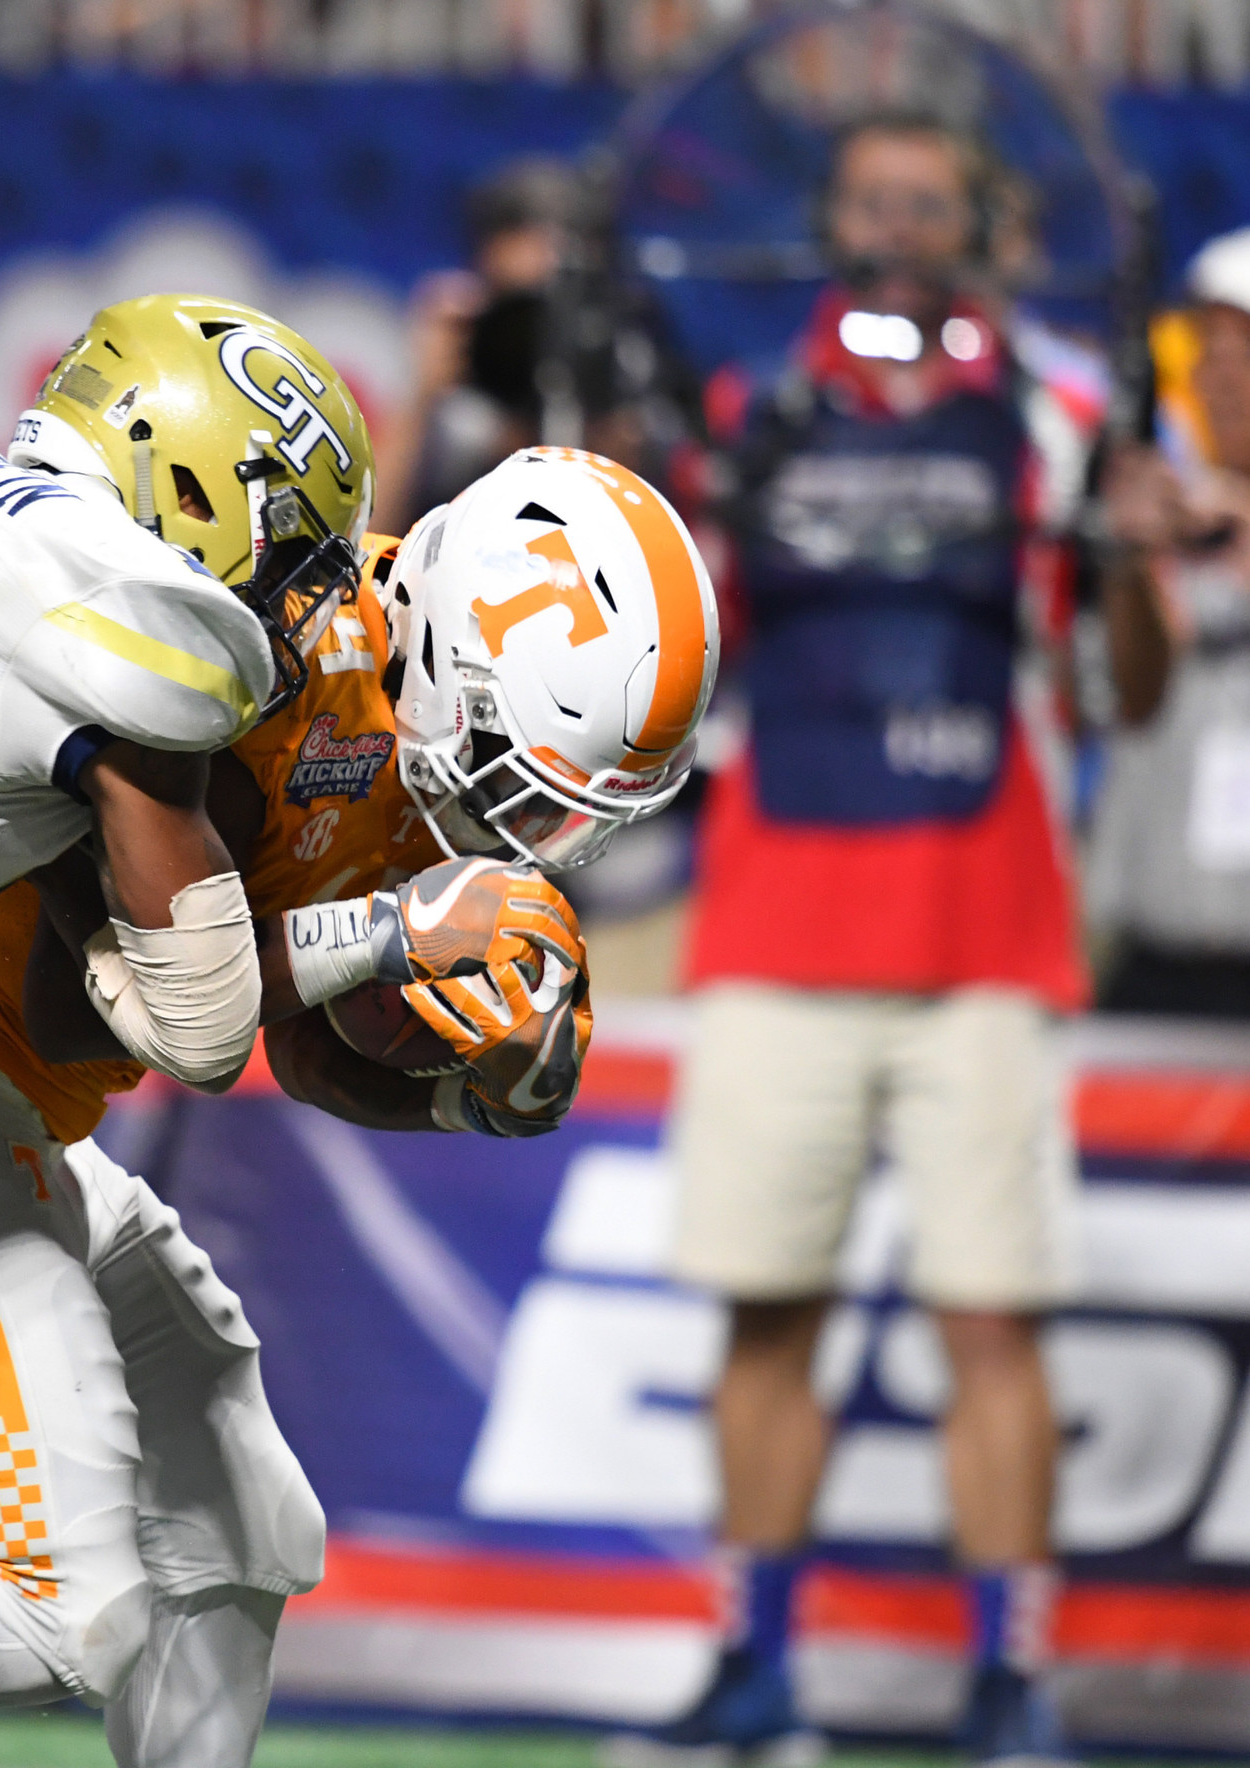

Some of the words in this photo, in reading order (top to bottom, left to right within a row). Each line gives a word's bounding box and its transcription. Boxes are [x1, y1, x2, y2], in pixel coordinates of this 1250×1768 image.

[219, 331, 352, 476] GT
[471, 528, 609, 659] T
[289, 757, 384, 787] KICKOFF
[301, 781, 360, 798] GAME
